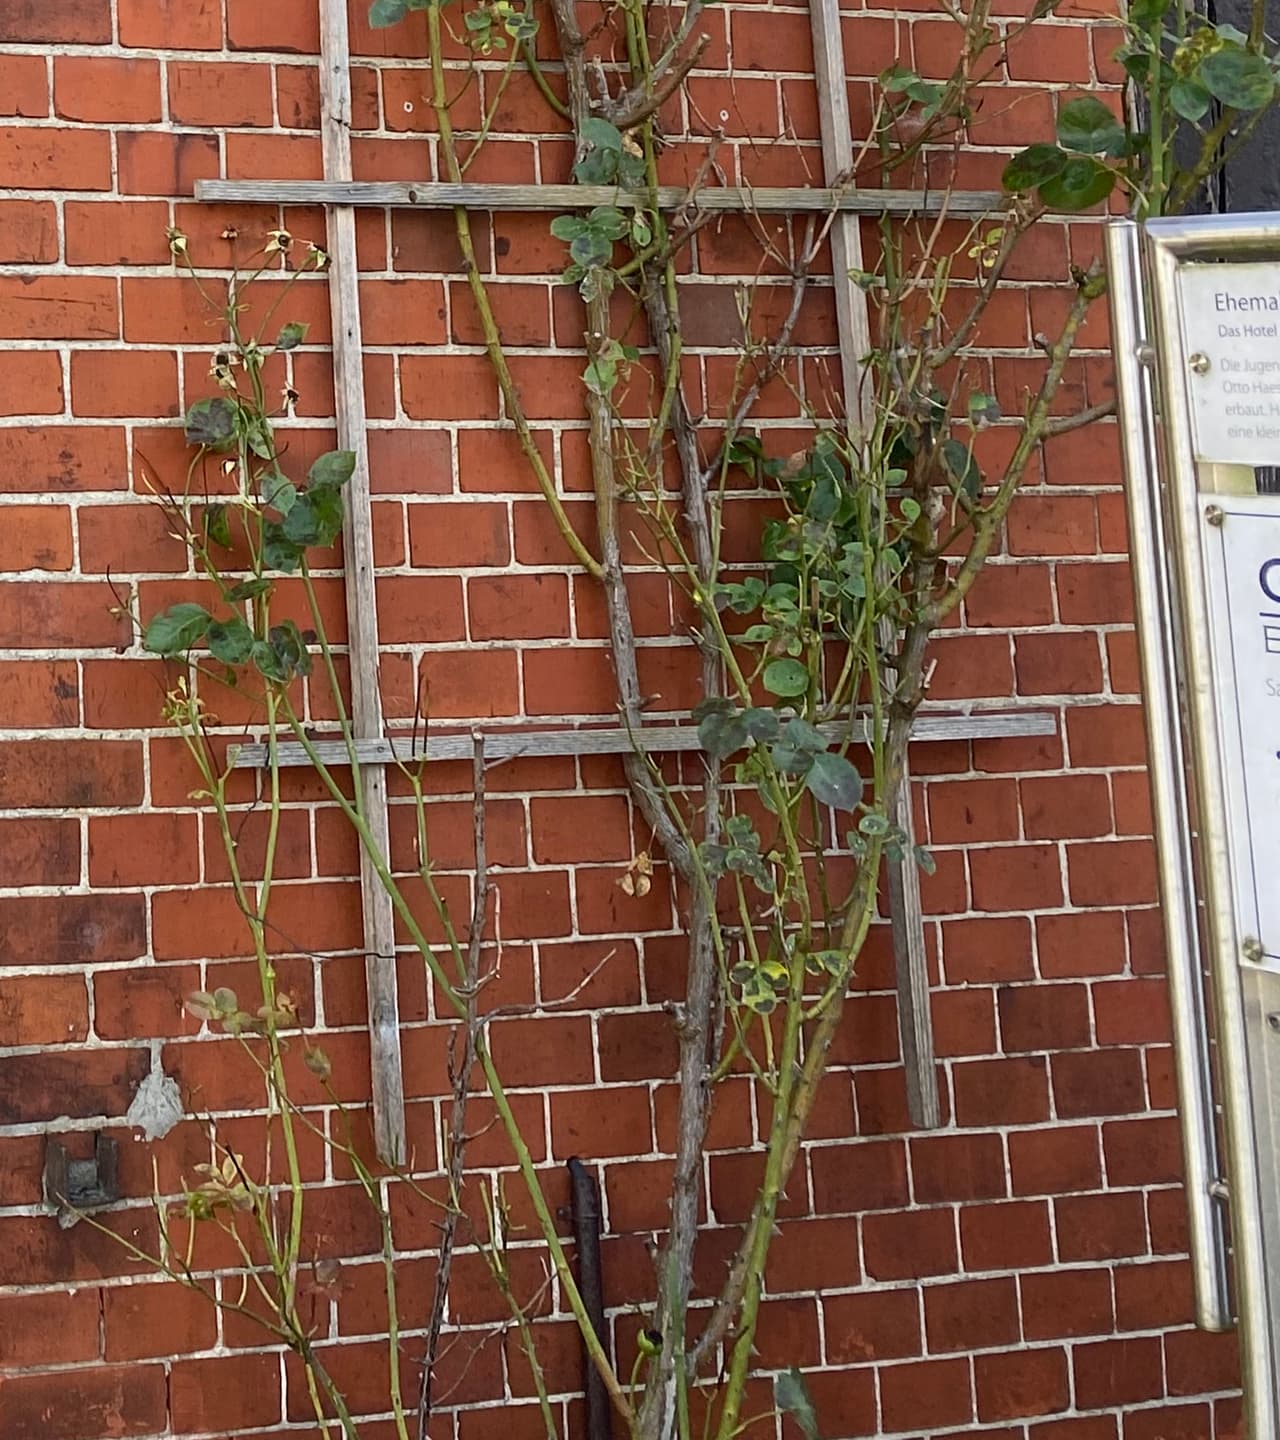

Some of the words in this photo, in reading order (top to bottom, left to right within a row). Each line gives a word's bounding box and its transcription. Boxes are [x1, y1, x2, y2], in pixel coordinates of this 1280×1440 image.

[1215, 292, 1280, 311] Ehema
[1218, 324, 1241, 337] Das
[1243, 323, 1278, 337] Hotel
[1221, 358, 1240, 372] Die
[1223, 380, 1250, 394] Otto
[1227, 426, 1253, 438] eine
